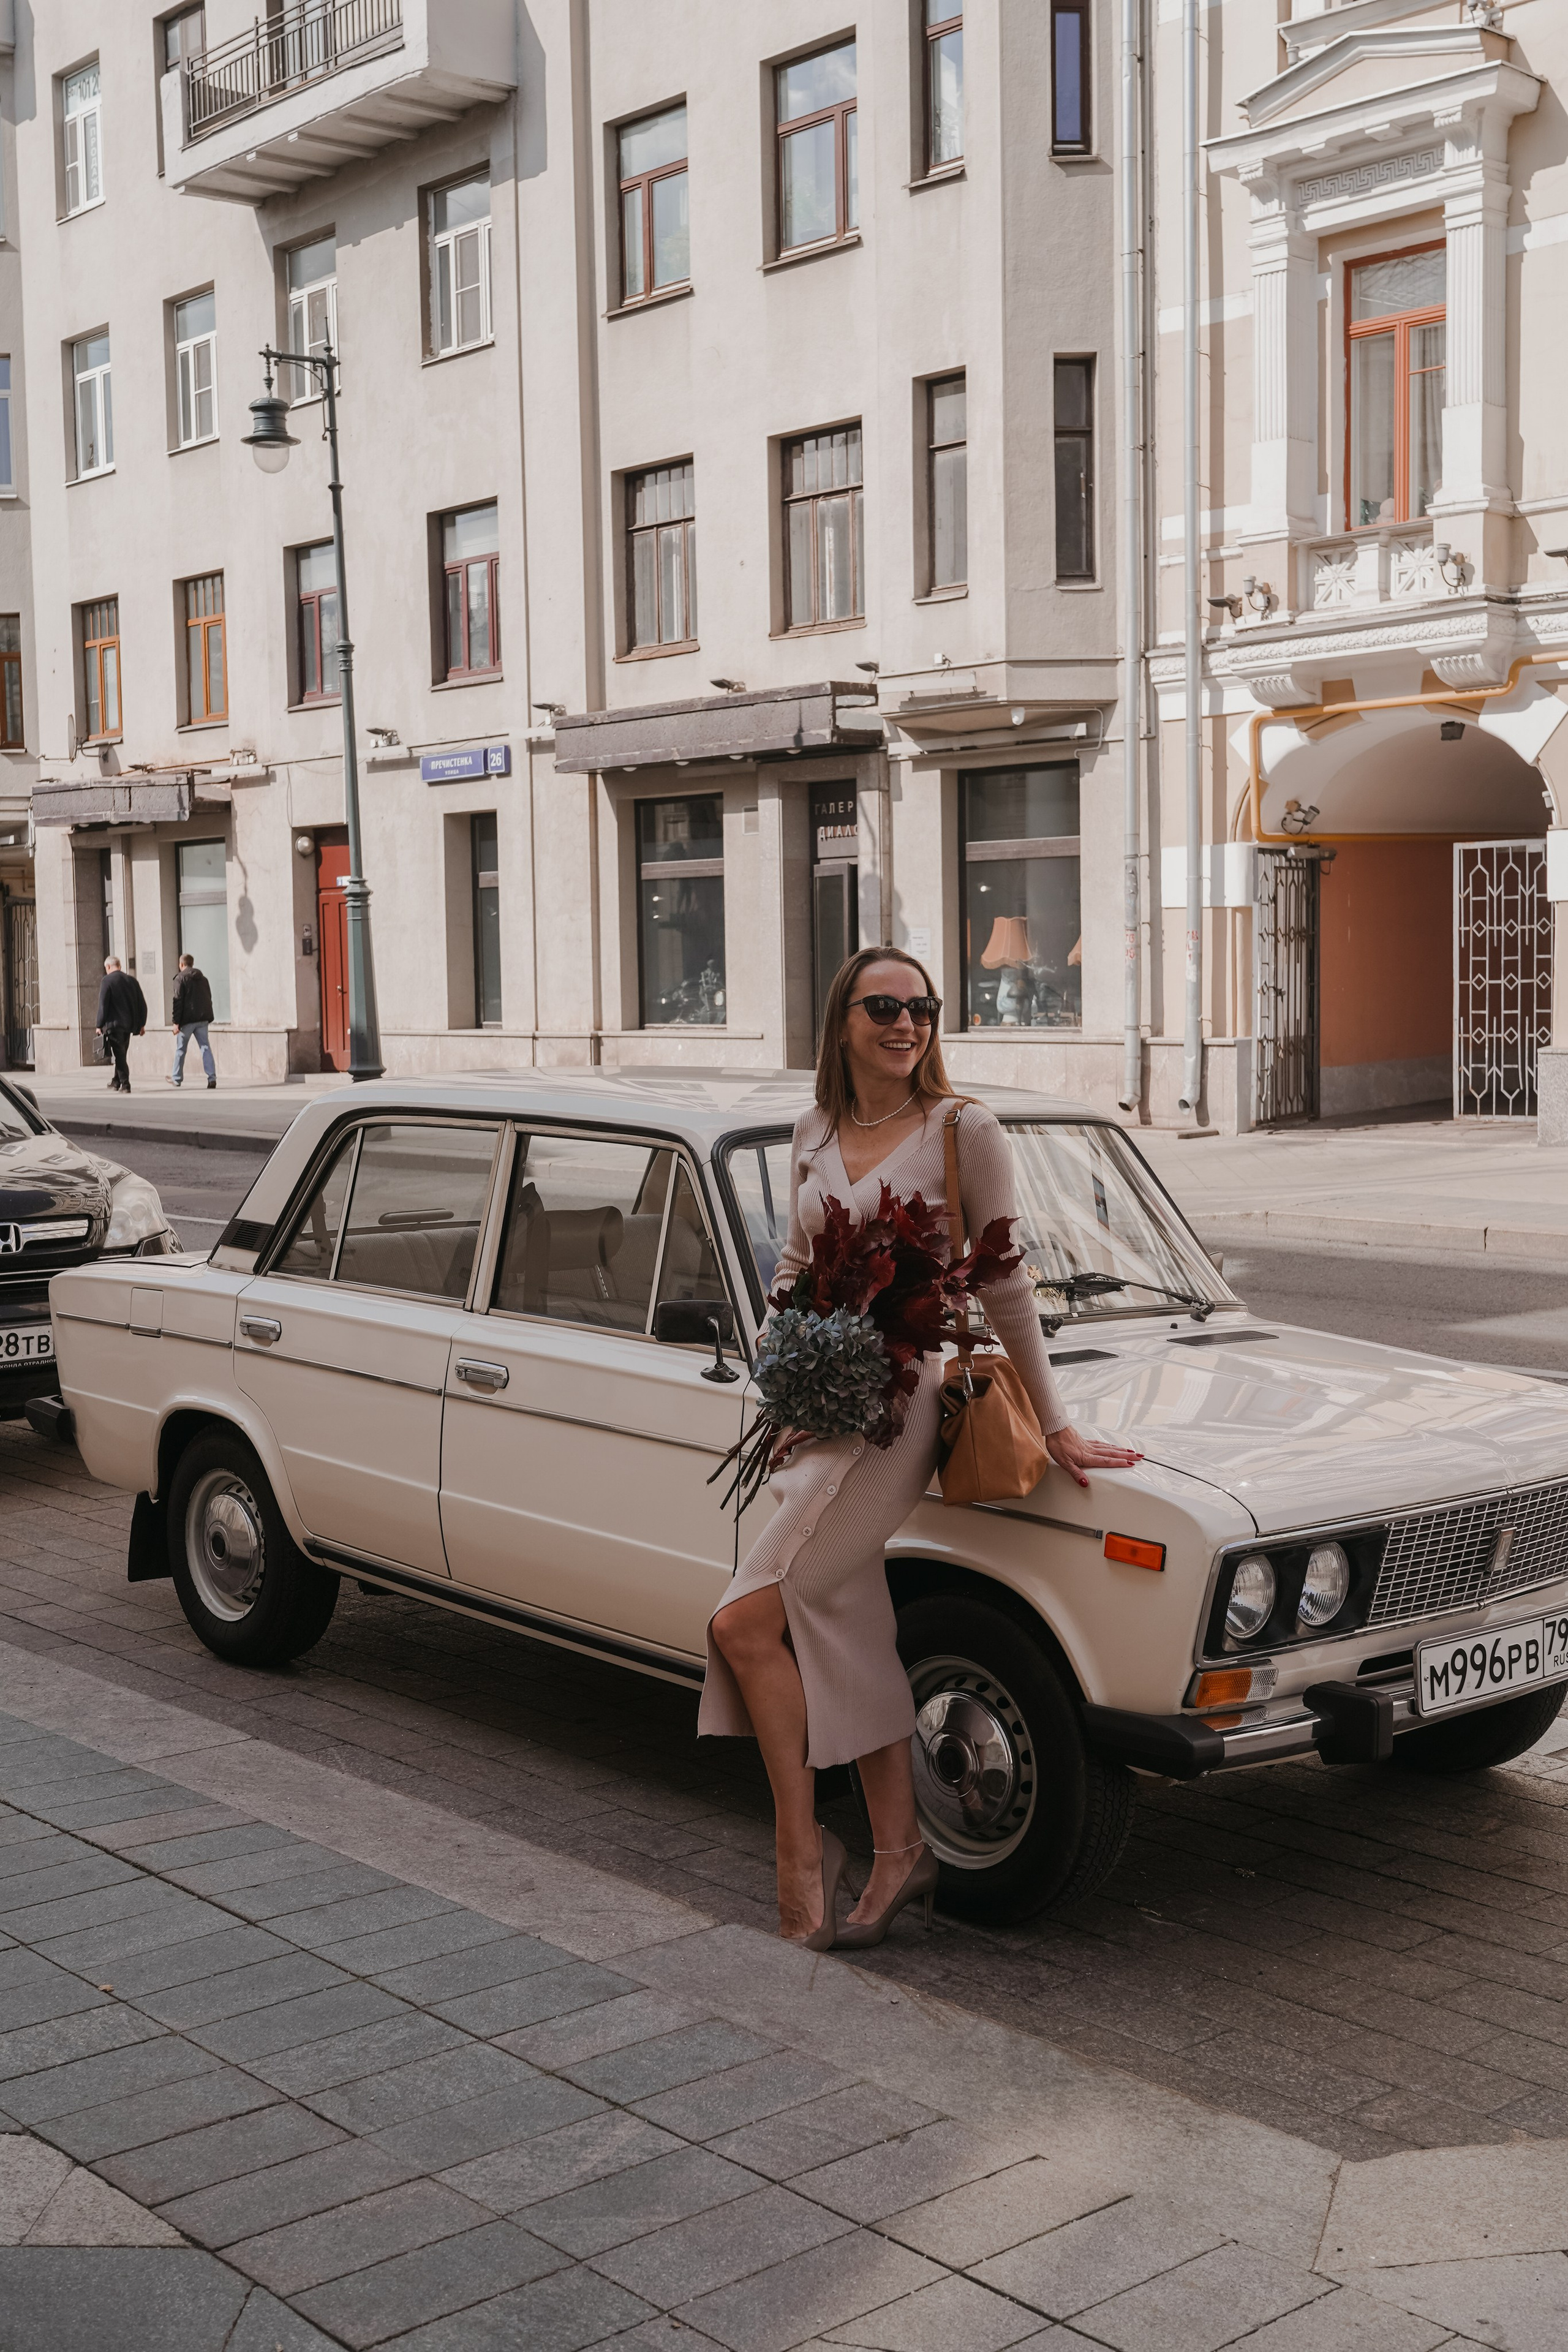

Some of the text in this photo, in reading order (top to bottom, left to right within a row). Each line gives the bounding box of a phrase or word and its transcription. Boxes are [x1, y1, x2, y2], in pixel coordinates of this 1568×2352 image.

[79, 76, 91, 102] 101
[90, 126, 99, 197] ПРОДАЖА
[431, 756, 473, 770] ПРЕЧИСТЕНКА
[490, 752, 502, 766] 26
[814, 801, 854, 815] ГАЛЕР
[0, 1332, 50, 1359] 8ТВ
[1430, 1637, 1539, 1700] М996РВ
